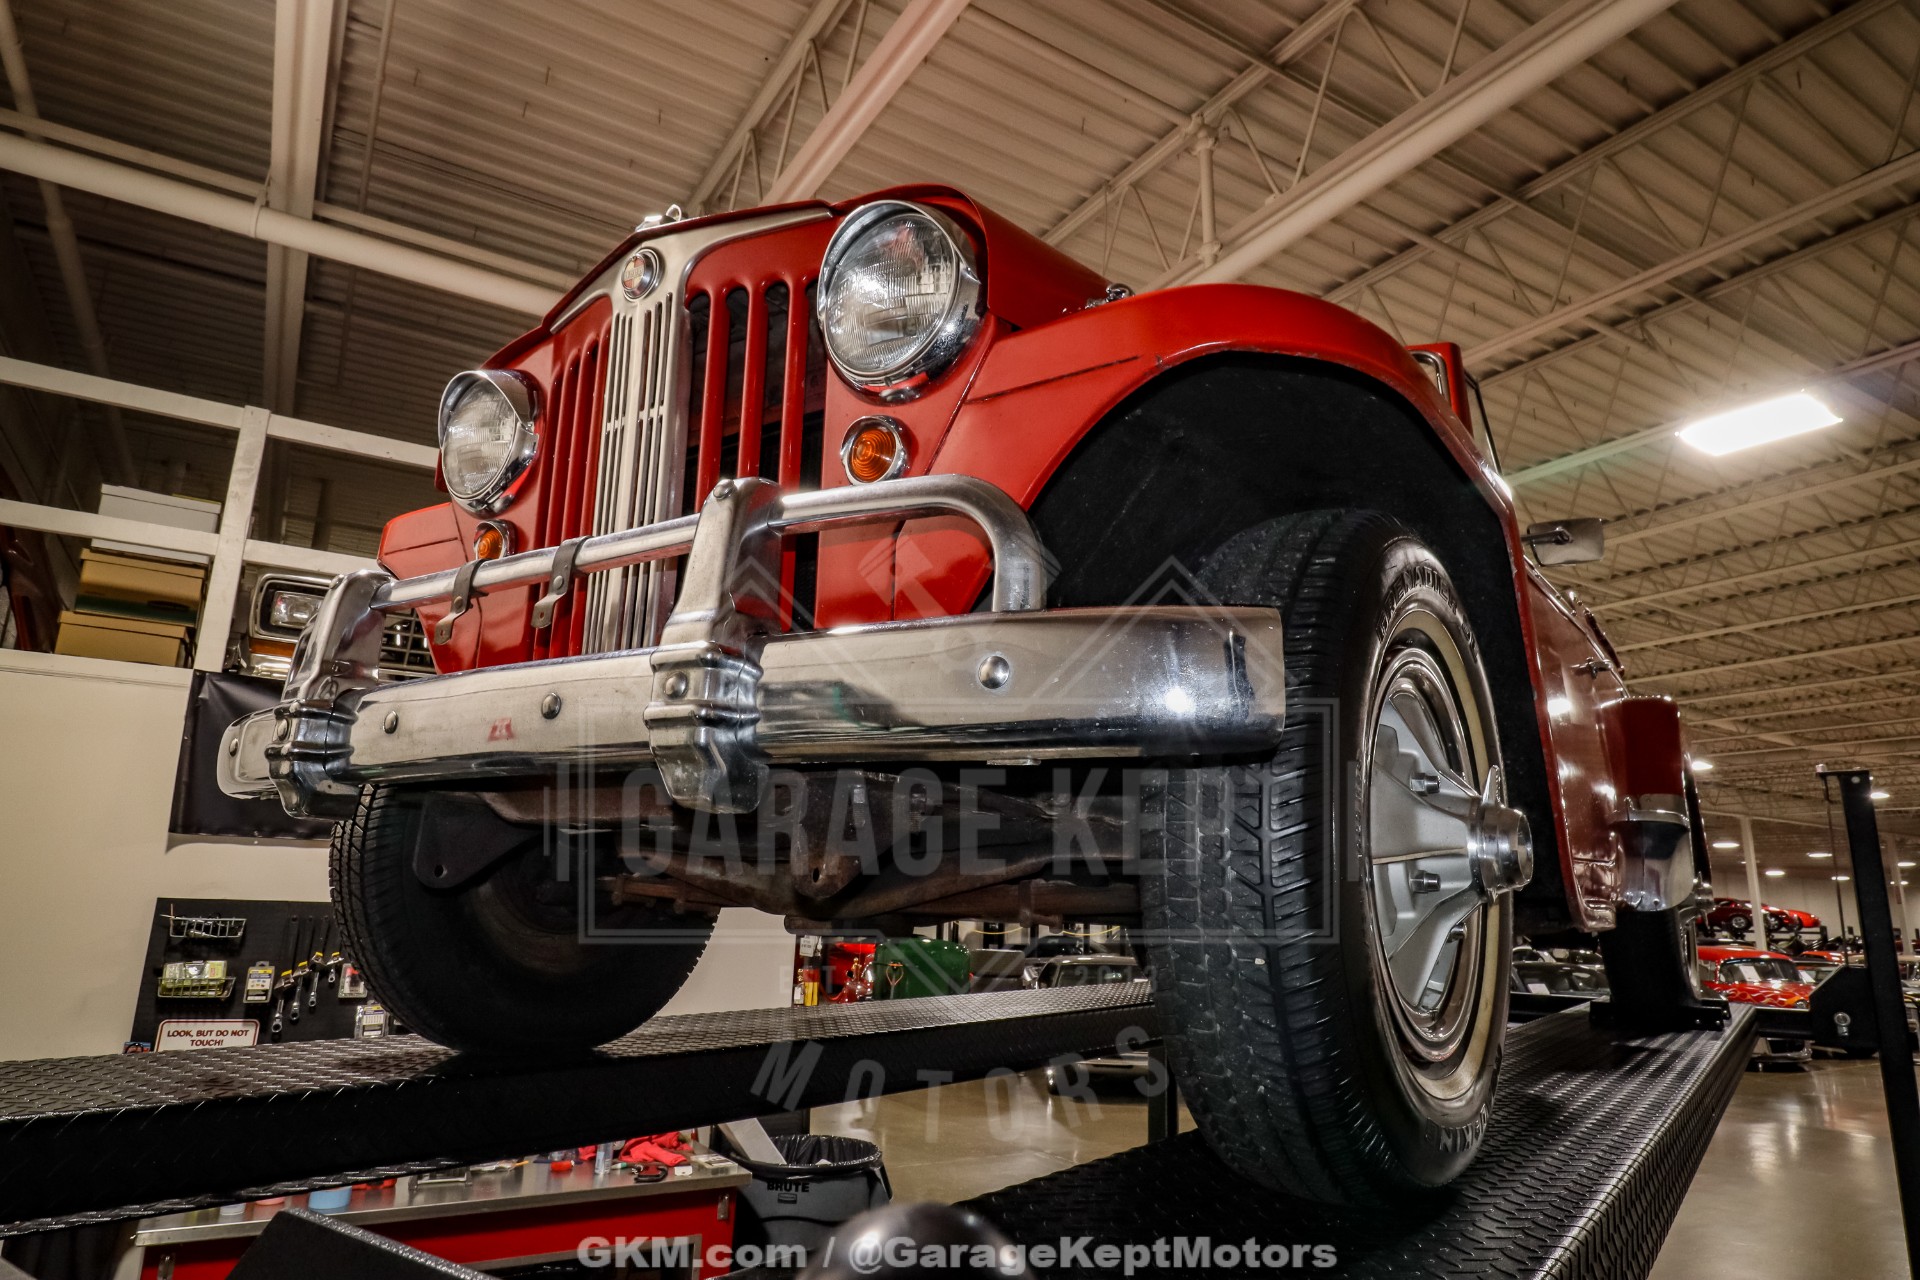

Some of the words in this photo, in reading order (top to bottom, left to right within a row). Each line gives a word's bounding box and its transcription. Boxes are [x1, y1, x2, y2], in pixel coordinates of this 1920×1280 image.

[167, 1030, 193, 1038] LOOK,
[190, 1039, 224, 1047] TOUCH!
[767, 1181, 810, 1192] BRUTE
